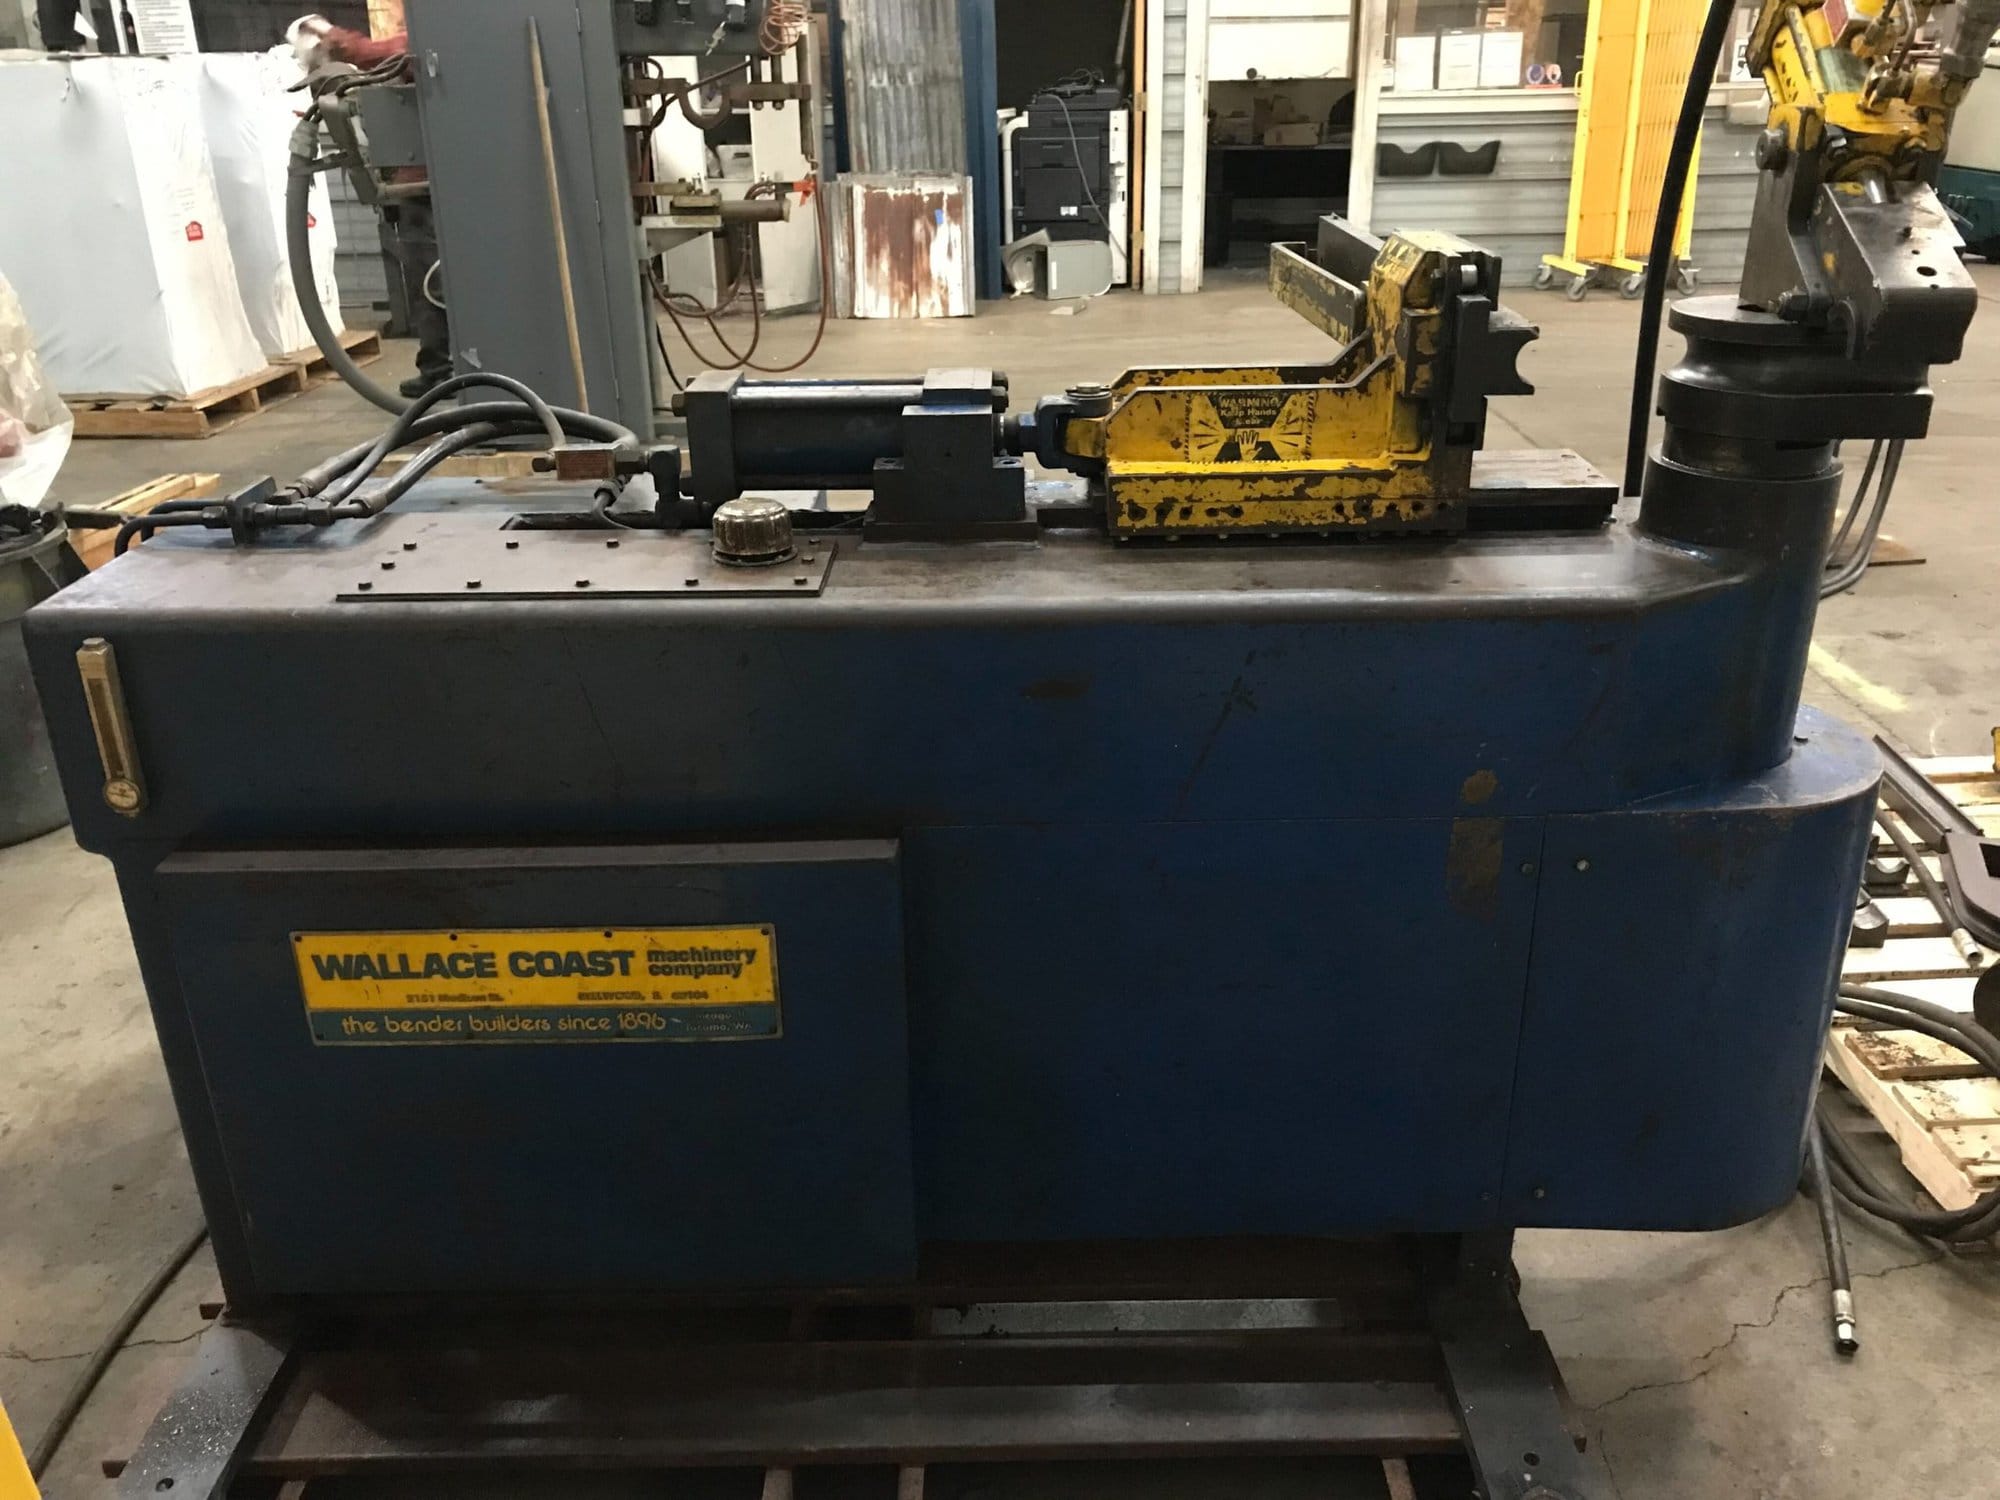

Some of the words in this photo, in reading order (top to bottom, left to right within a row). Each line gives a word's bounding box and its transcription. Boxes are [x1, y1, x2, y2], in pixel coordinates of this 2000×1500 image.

[311, 953, 499, 981] WALLACE
[508, 950, 635, 978] COAST
[647, 946, 757, 964] machinery
[648, 963, 743, 979] company
[341, 1015, 378, 1036] the
[384, 1014, 463, 1033] bender
[468, 1013, 550, 1032] builders
[558, 1013, 611, 1032] since
[617, 1011, 667, 1030] 1896
